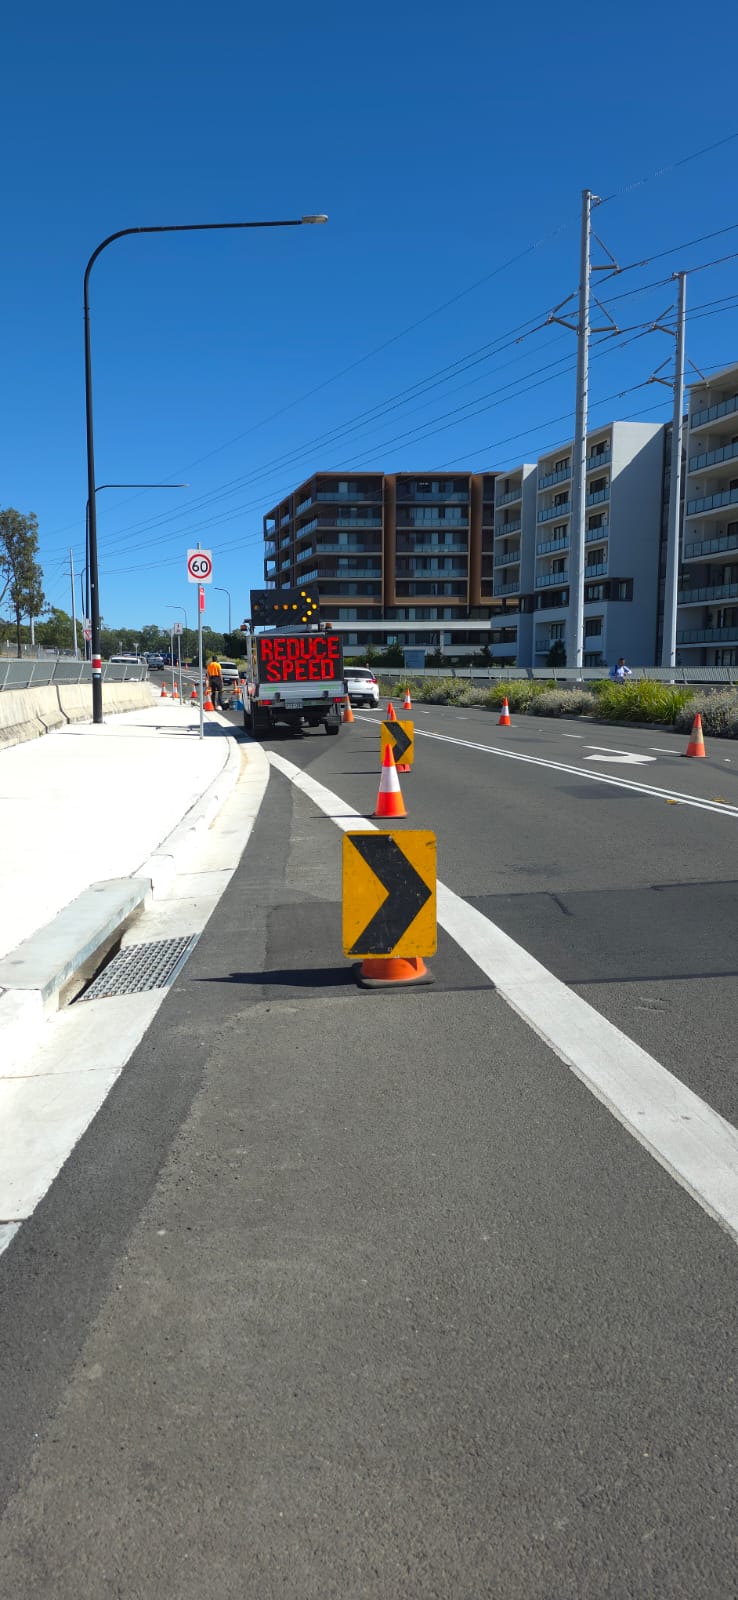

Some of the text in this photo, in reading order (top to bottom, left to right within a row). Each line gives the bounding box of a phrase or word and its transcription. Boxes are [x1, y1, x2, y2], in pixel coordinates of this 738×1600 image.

[191, 560, 208, 573] 60
[261, 637, 339, 660] REDUCE
[266, 660, 335, 682] SPEED
